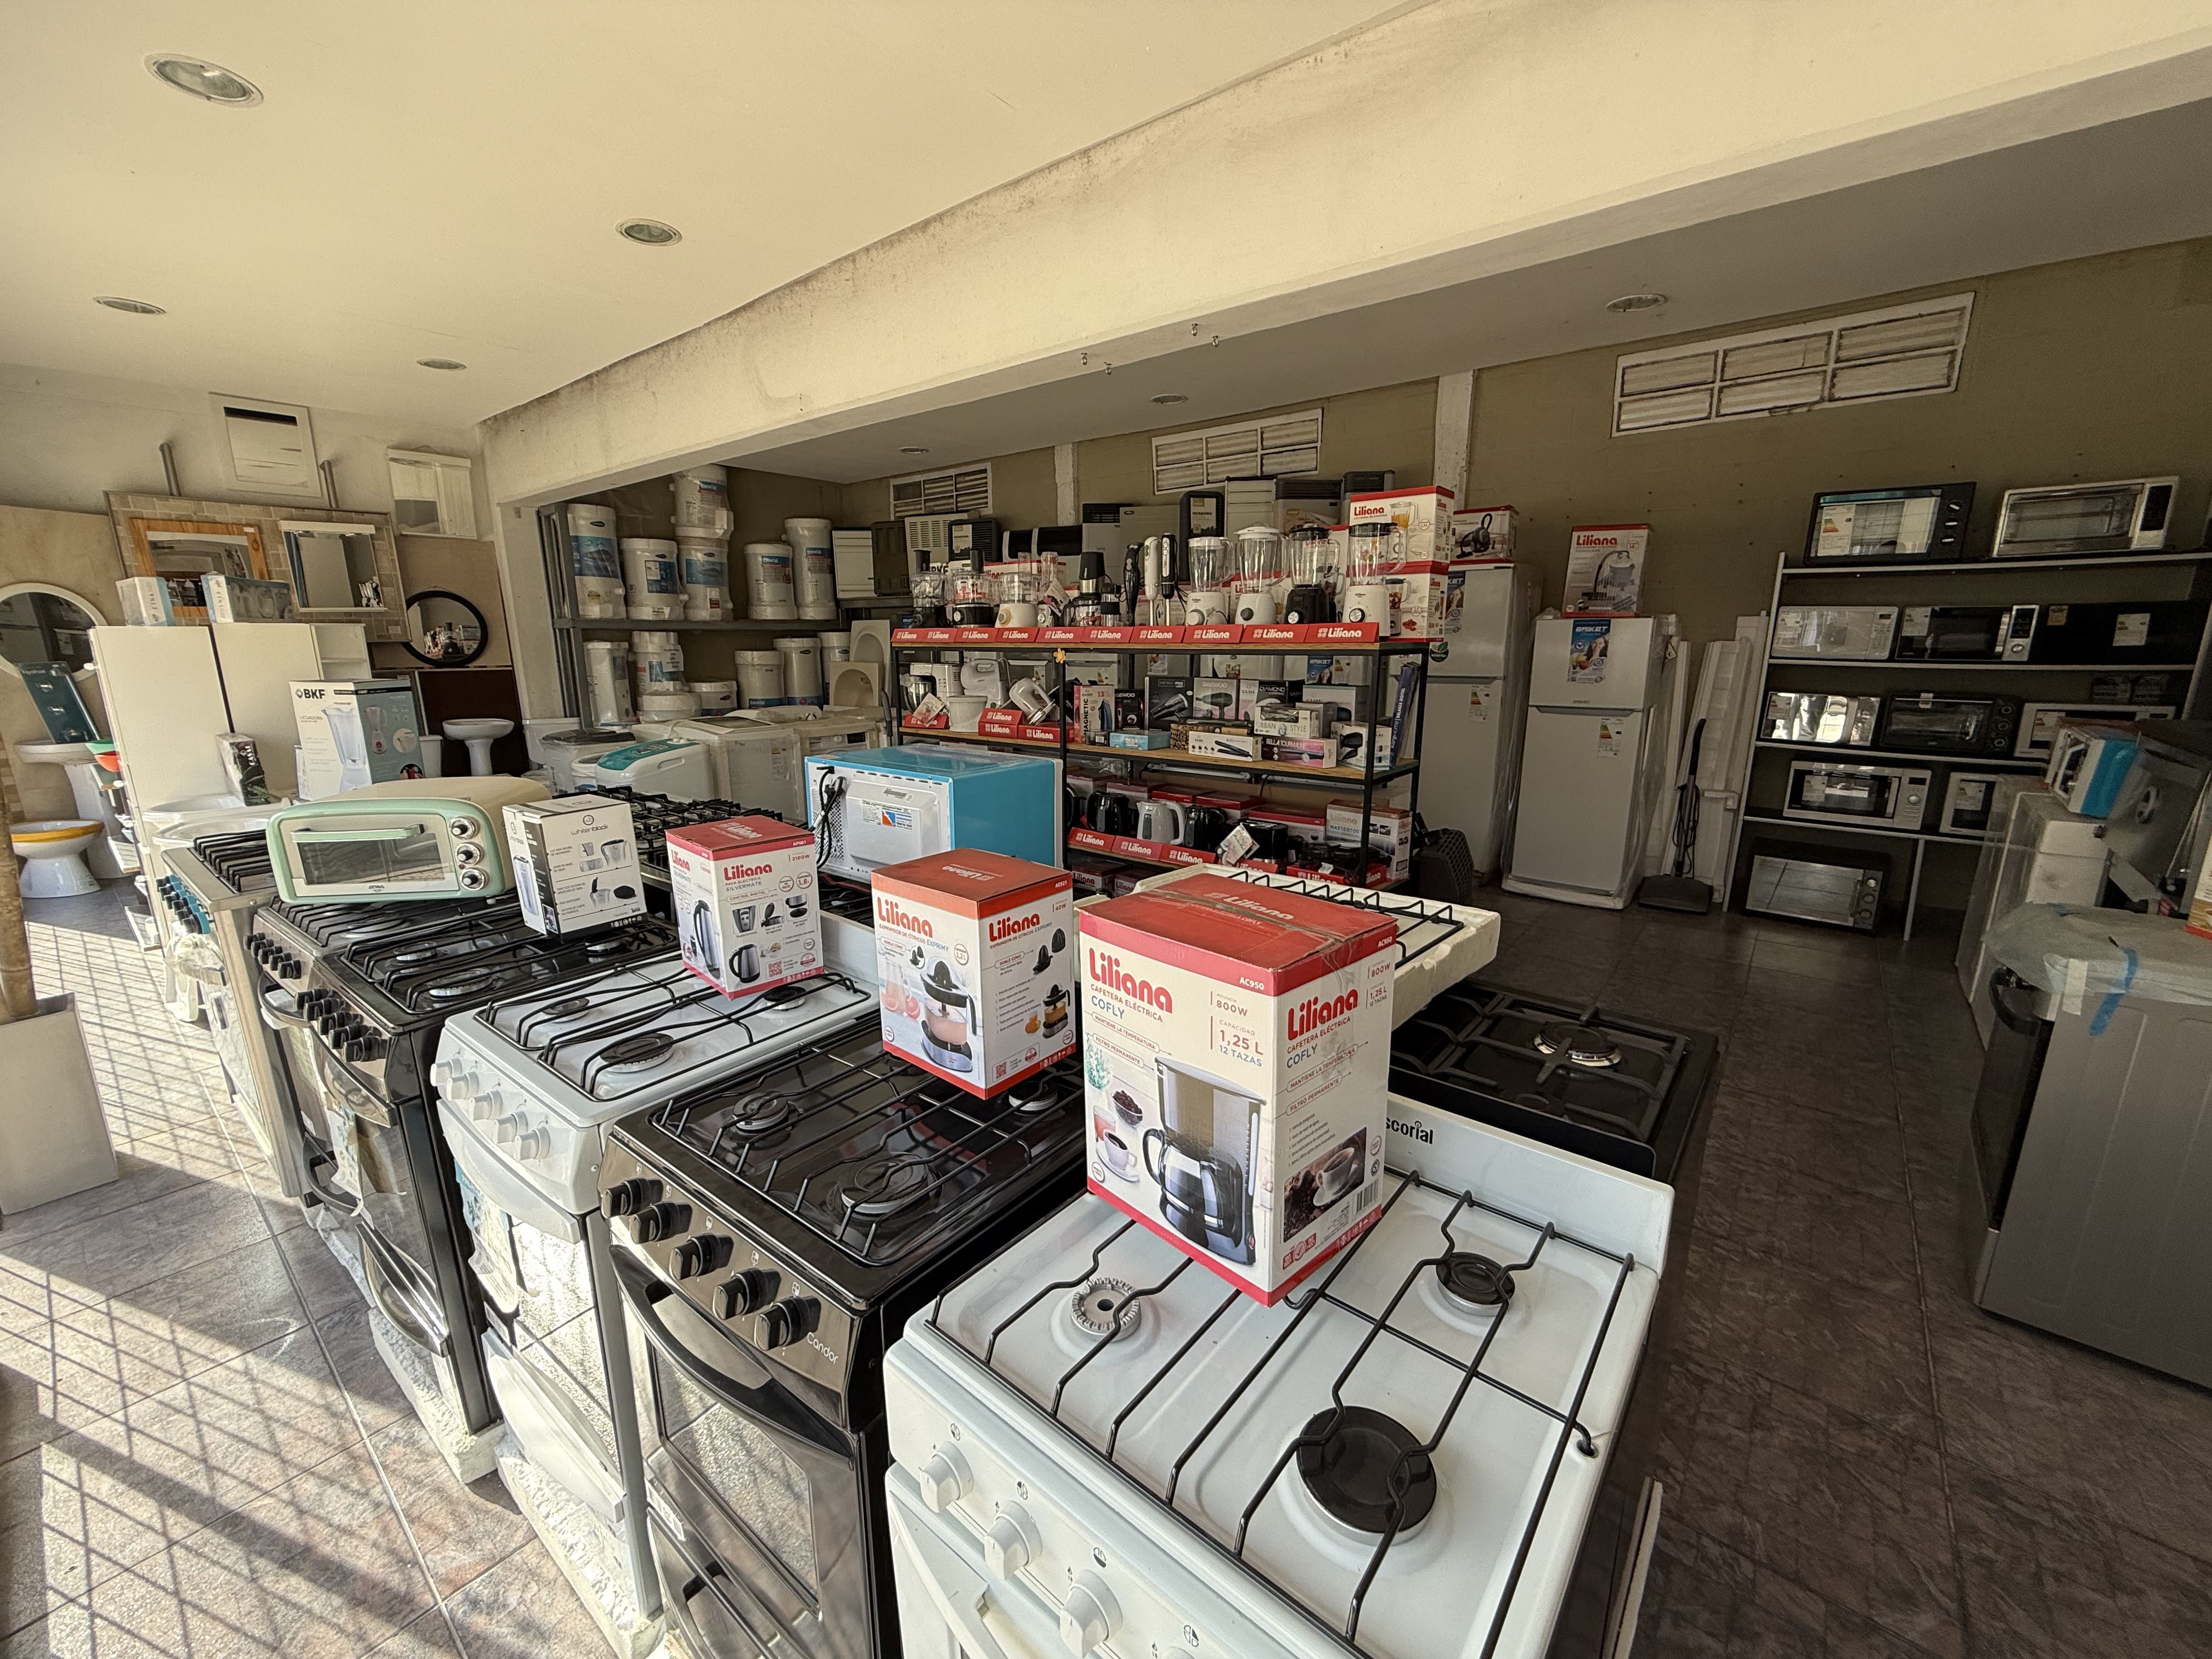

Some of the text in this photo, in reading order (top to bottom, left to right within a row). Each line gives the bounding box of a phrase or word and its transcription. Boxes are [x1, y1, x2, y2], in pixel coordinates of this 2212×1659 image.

[1354, 506, 1385, 517] Liliana
[1576, 535, 1618, 546] Liliana
[968, 631, 989, 639] Liliana
[1009, 630, 1029, 639] Liliana
[1052, 630, 1074, 639] Liliana
[1097, 630, 1121, 639] Liliana
[1147, 630, 1172, 639] Liliana
[1201, 629, 1230, 639] Liliana
[1262, 629, 1294, 639] Liliana
[1327, 627, 1362, 638] Liliana
[303, 689, 325, 699] BKF
[992, 713, 1013, 721] Liliana
[990, 725, 1011, 734] Liliana
[1032, 730, 1053, 740] Liliana
[1290, 724, 1307, 732] STYLE
[1330, 824, 1363, 834] MASTERTOS
[1082, 834, 1104, 846] Liliana
[1127, 842, 1152, 855] Liliana
[1177, 851, 1203, 865] Liliana
[724, 864, 772, 881] Liliana
[1073, 871, 1096, 885] Liliana
[725, 881, 762, 891] SILVERMATE
[1055, 903, 1066, 911] 40W
[1223, 896, 1295, 920] Liliana
[877, 896, 933, 938] Liliana
[989, 913, 1040, 942] Liliana
[927, 939, 949, 952] EXPRIMY
[1371, 962, 1391, 978] 800W
[1089, 947, 1173, 1014] Liliana
[1239, 977, 1265, 991] AC950
[1370, 988, 1382, 1000] 1,25
[1091, 984, 1163, 1023] CAFETERA ELÉCTRICA
[1091, 995, 1125, 1020] COFLY
[1216, 1000, 1248, 1017] 800W
[1288, 989, 1358, 1041] Liliana
[1095, 1015, 1156, 1050] MANTIENE LA TEMPERATURA
[1219, 1019, 1256, 1036] CAPACIDAD
[1287, 1015, 1351, 1054] CAFETERA ELÉCTRICA
[1220, 1029, 1264, 1056] 1,25 L
[1096, 1036, 1141, 1065] FILTRO PERMANENTE
[1219, 1045, 1263, 1068] 12 TAZAS
[1286, 1042, 1318, 1069] COFLY
[1290, 1047, 1356, 1089] MANTIENE LA TEMPERATURA
[1290, 1077, 1340, 1113] FILTRO PERMANENTE
[1386, 1116, 1434, 1145] scorial
[806, 1331, 839, 1364] Candor
